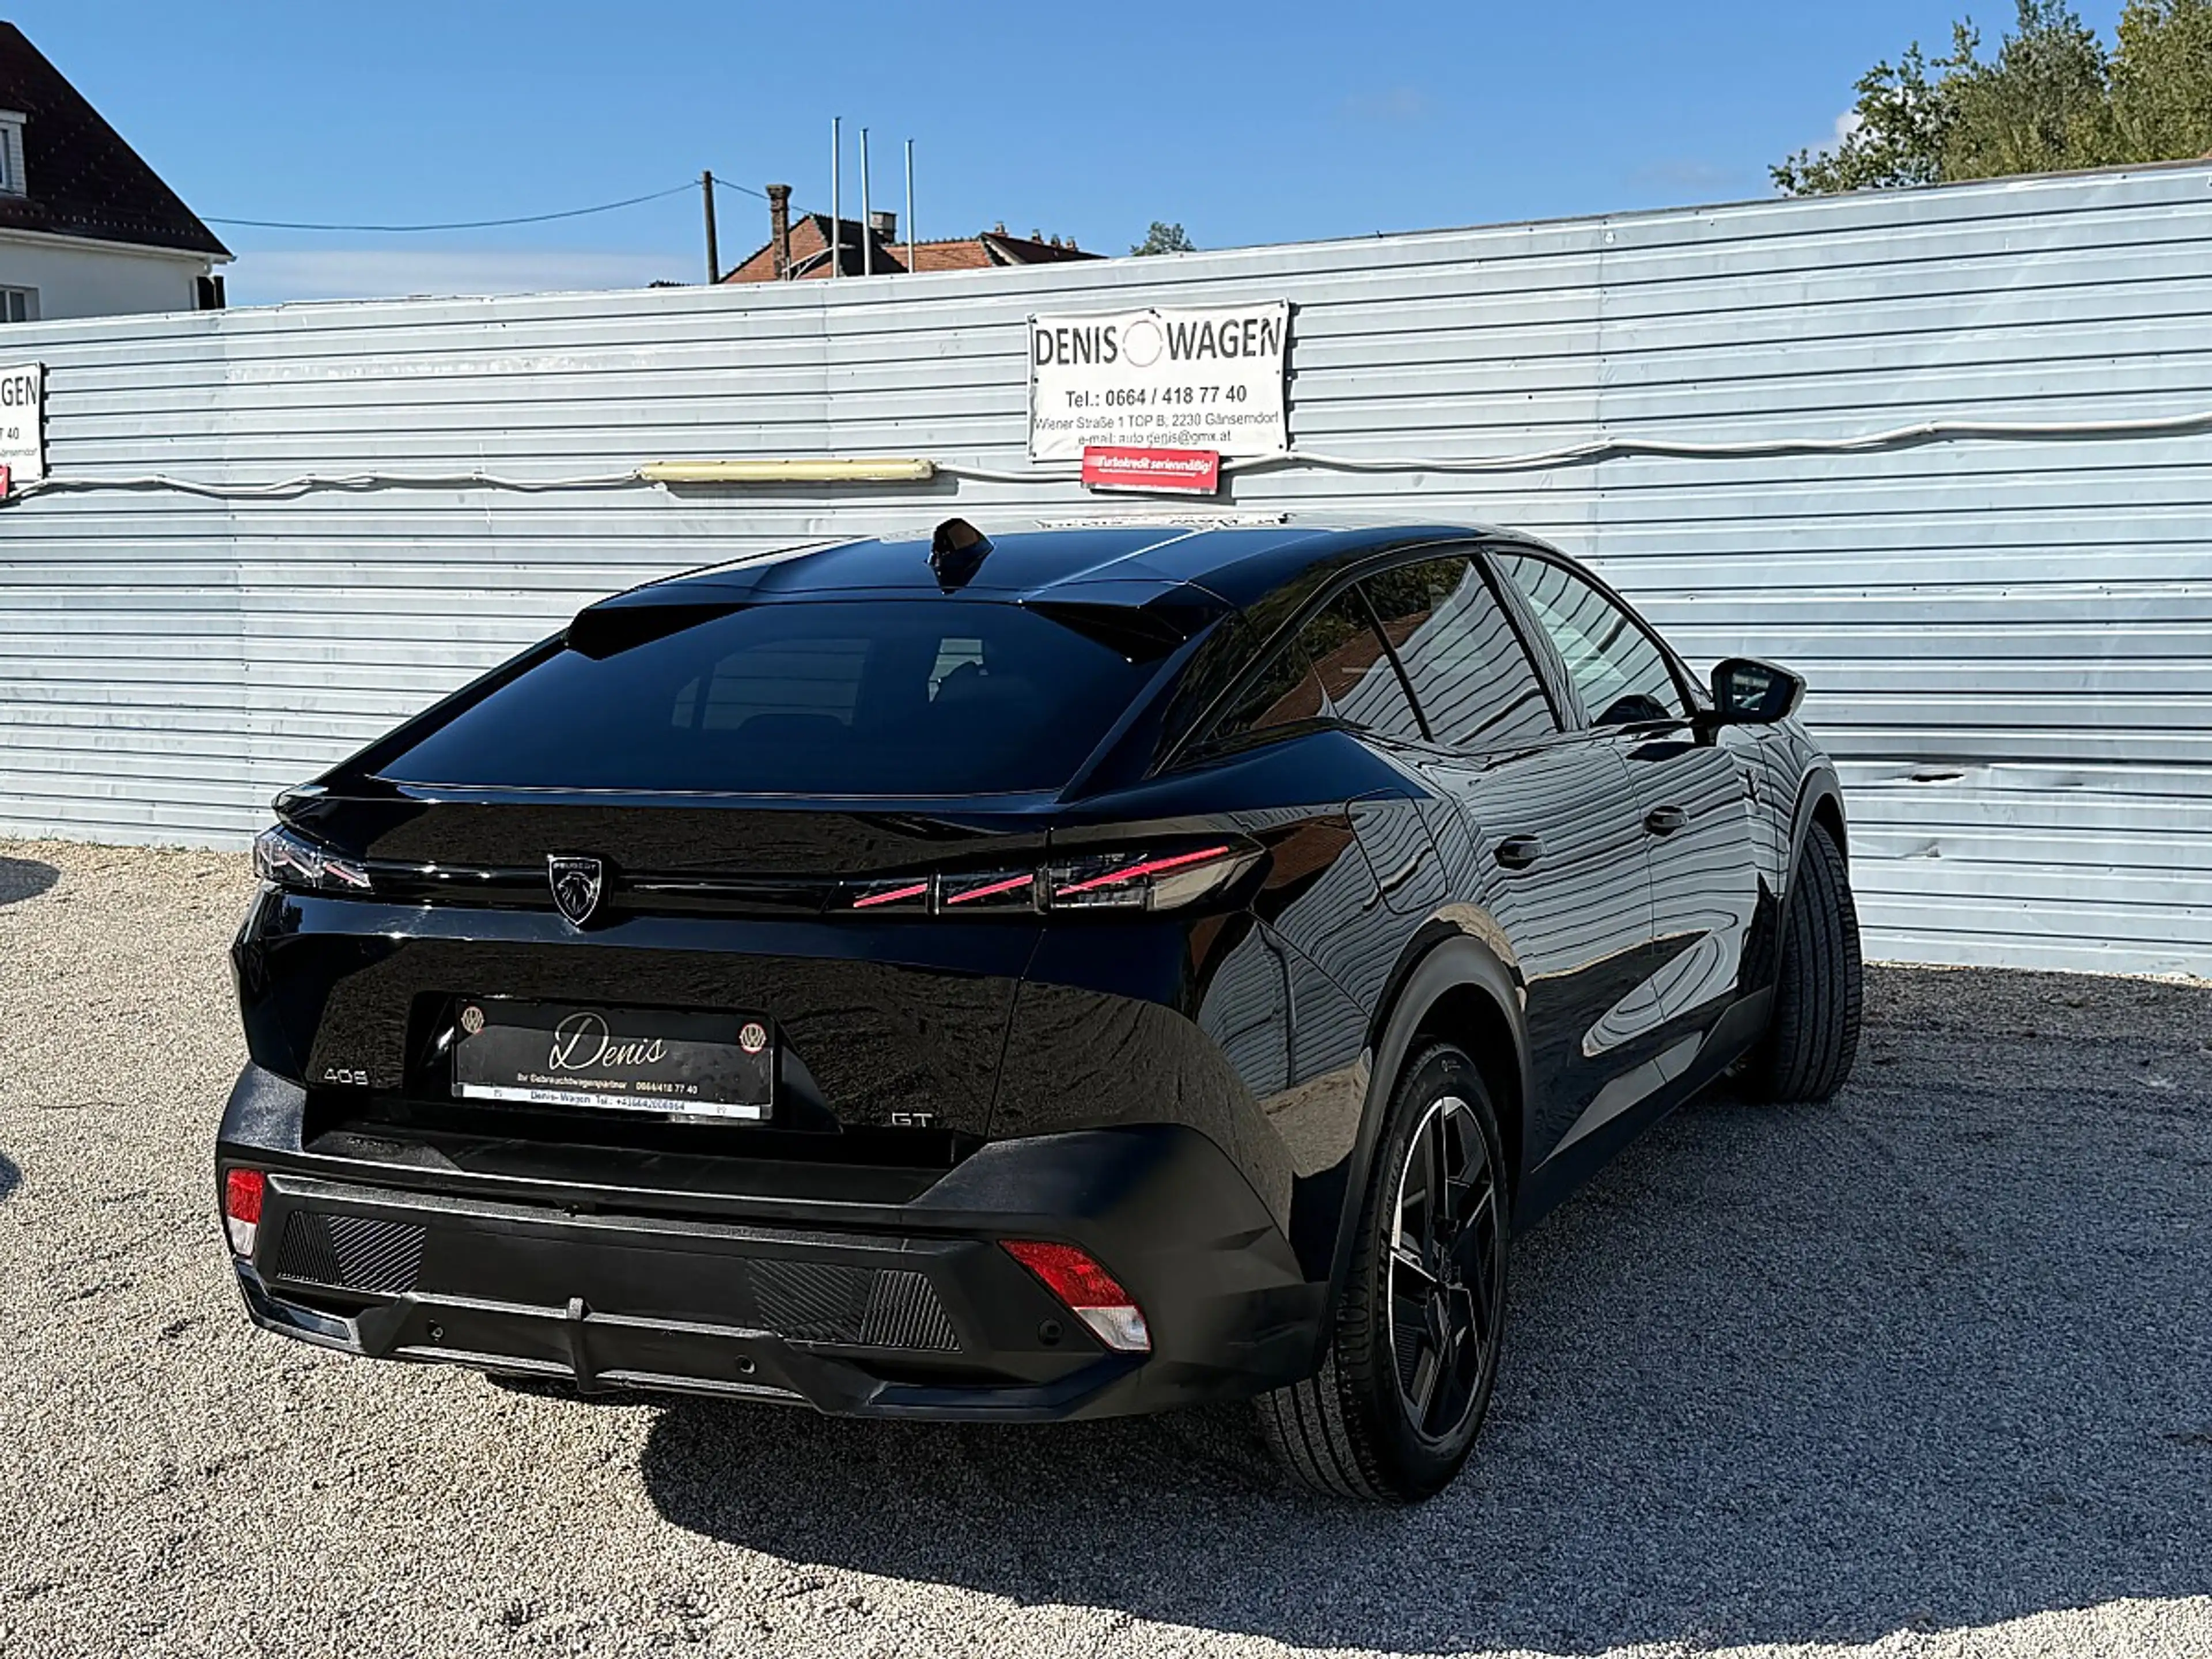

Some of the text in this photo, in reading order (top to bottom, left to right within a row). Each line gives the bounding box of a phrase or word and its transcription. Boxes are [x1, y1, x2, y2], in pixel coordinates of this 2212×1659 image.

[1035, 317, 1282, 366] DENIS WAGEN
[0, 376, 37, 407] GEN
[1066, 389, 1100, 408] Tel.:
[1105, 388, 1146, 407] 0664
[1161, 386, 1194, 404] 418
[1200, 386, 1220, 403] 77
[1225, 385, 1247, 403] 40
[1076, 416, 1115, 429] Straße
[1118, 416, 1124, 427] 1
[1172, 412, 1202, 427] 2230
[548, 1012, 668, 1071] Denis
[892, 1112, 933, 1127] GT
